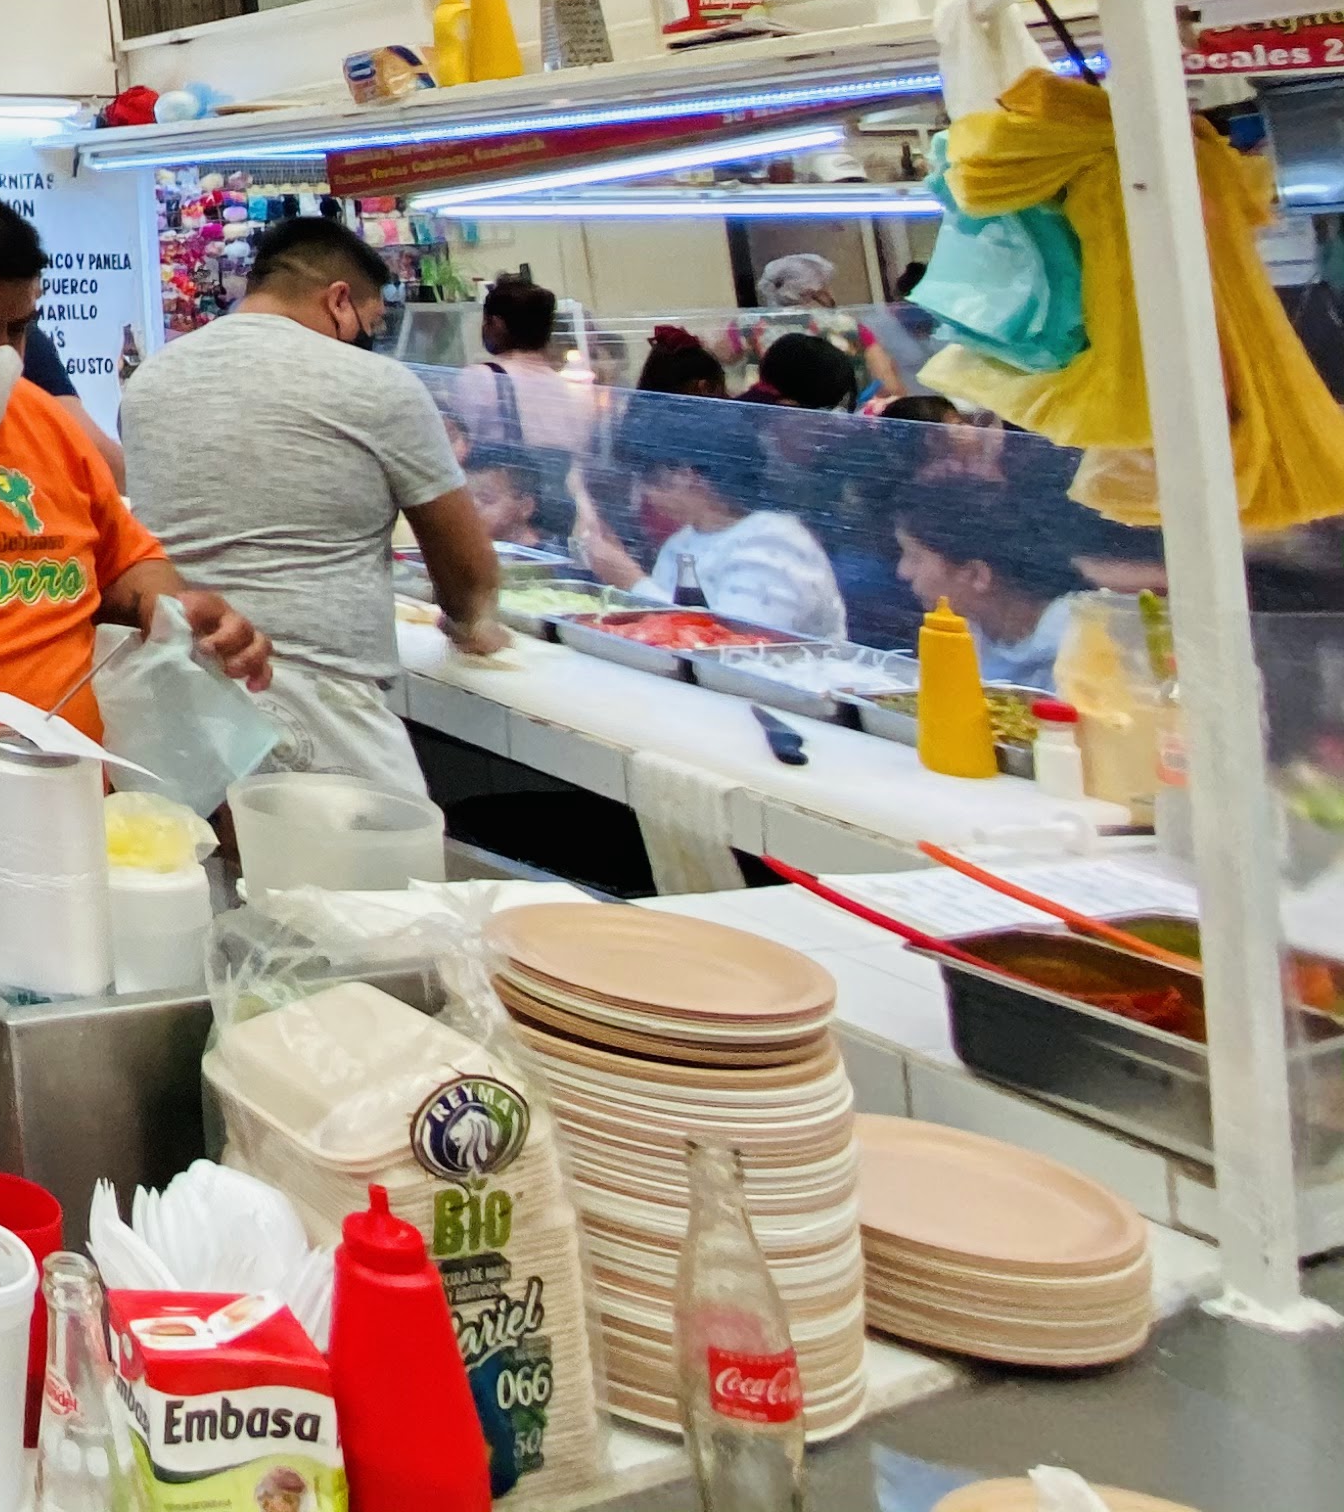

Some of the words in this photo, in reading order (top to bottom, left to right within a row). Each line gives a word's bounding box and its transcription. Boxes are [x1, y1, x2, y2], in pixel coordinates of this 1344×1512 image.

[1183, 43, 1311, 70] ocales
[76, 254, 83, 269] Y
[88, 254, 131, 270] PANELA
[43, 279, 97, 295] PUERCO
[67, 357, 114, 375] GUSTO
[430, 1083, 512, 1124] REYMA
[496, 1361, 552, 1410] 066
[163, 1396, 322, 1445] Embasa
